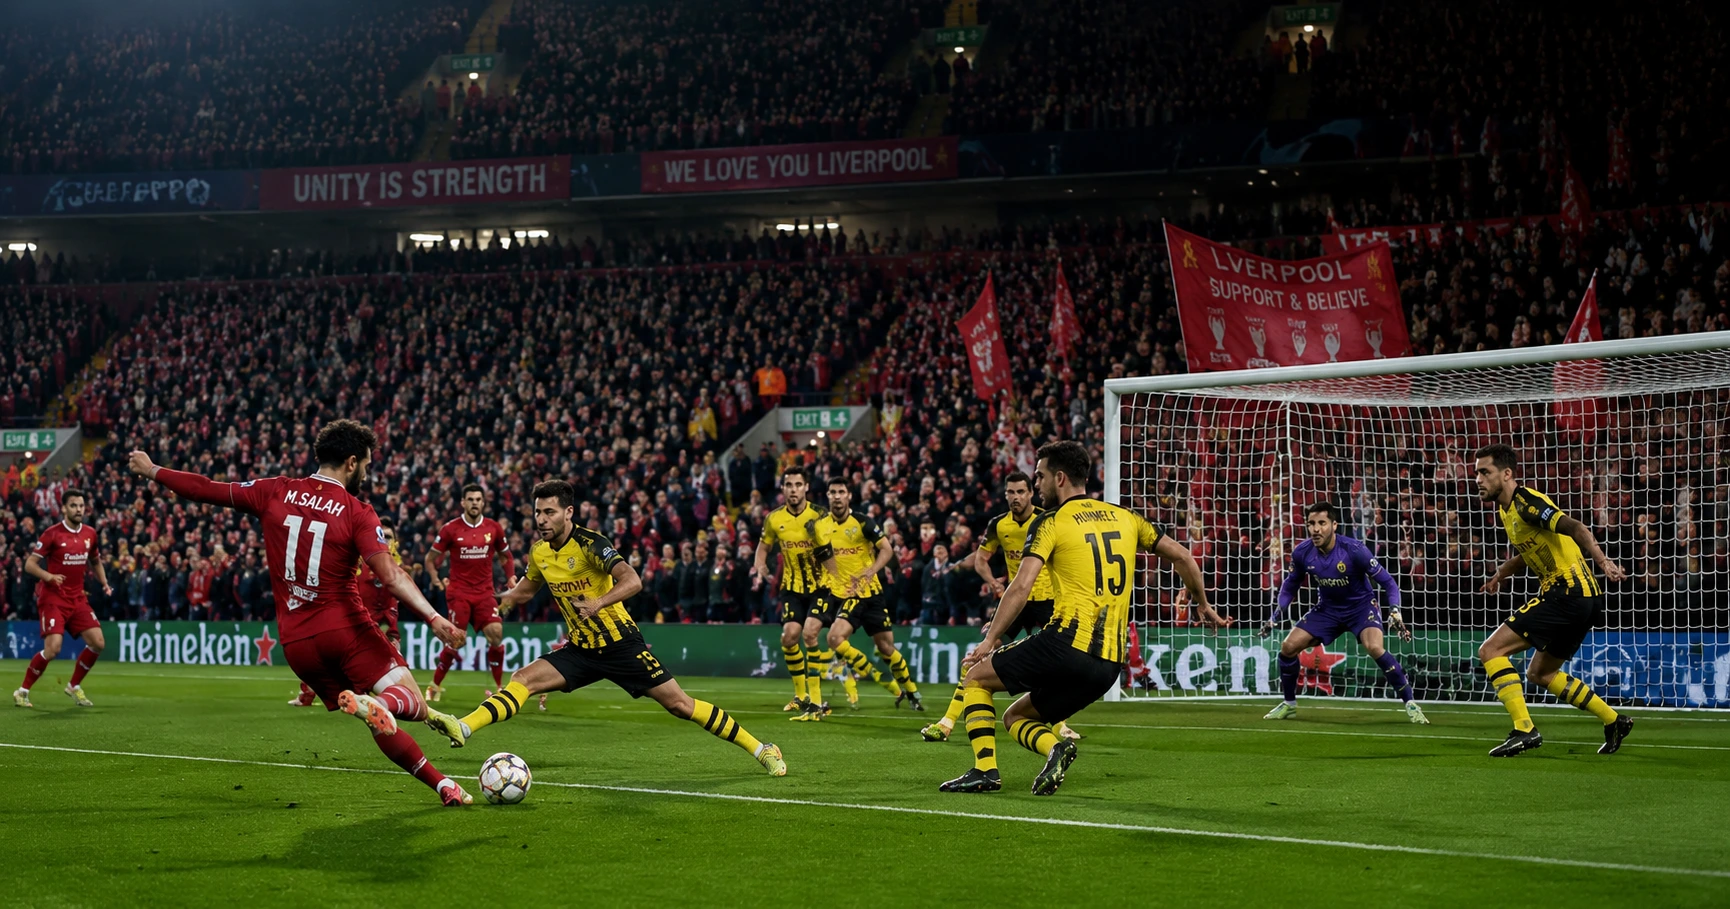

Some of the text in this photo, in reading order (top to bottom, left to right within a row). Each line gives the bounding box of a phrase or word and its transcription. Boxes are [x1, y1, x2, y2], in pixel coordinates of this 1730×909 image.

[294, 164, 547, 203] UNITY IS STRENGTH
[664, 147, 933, 183] WE LOVE YOU LIVERPOOL
[1209, 277, 1369, 311] SUPPORT & BELIEVE
[284, 490, 345, 517] M.SALAH
[283, 514, 327, 587] 11
[1084, 531, 1126, 596] 15
[118, 622, 250, 666] Heineken
